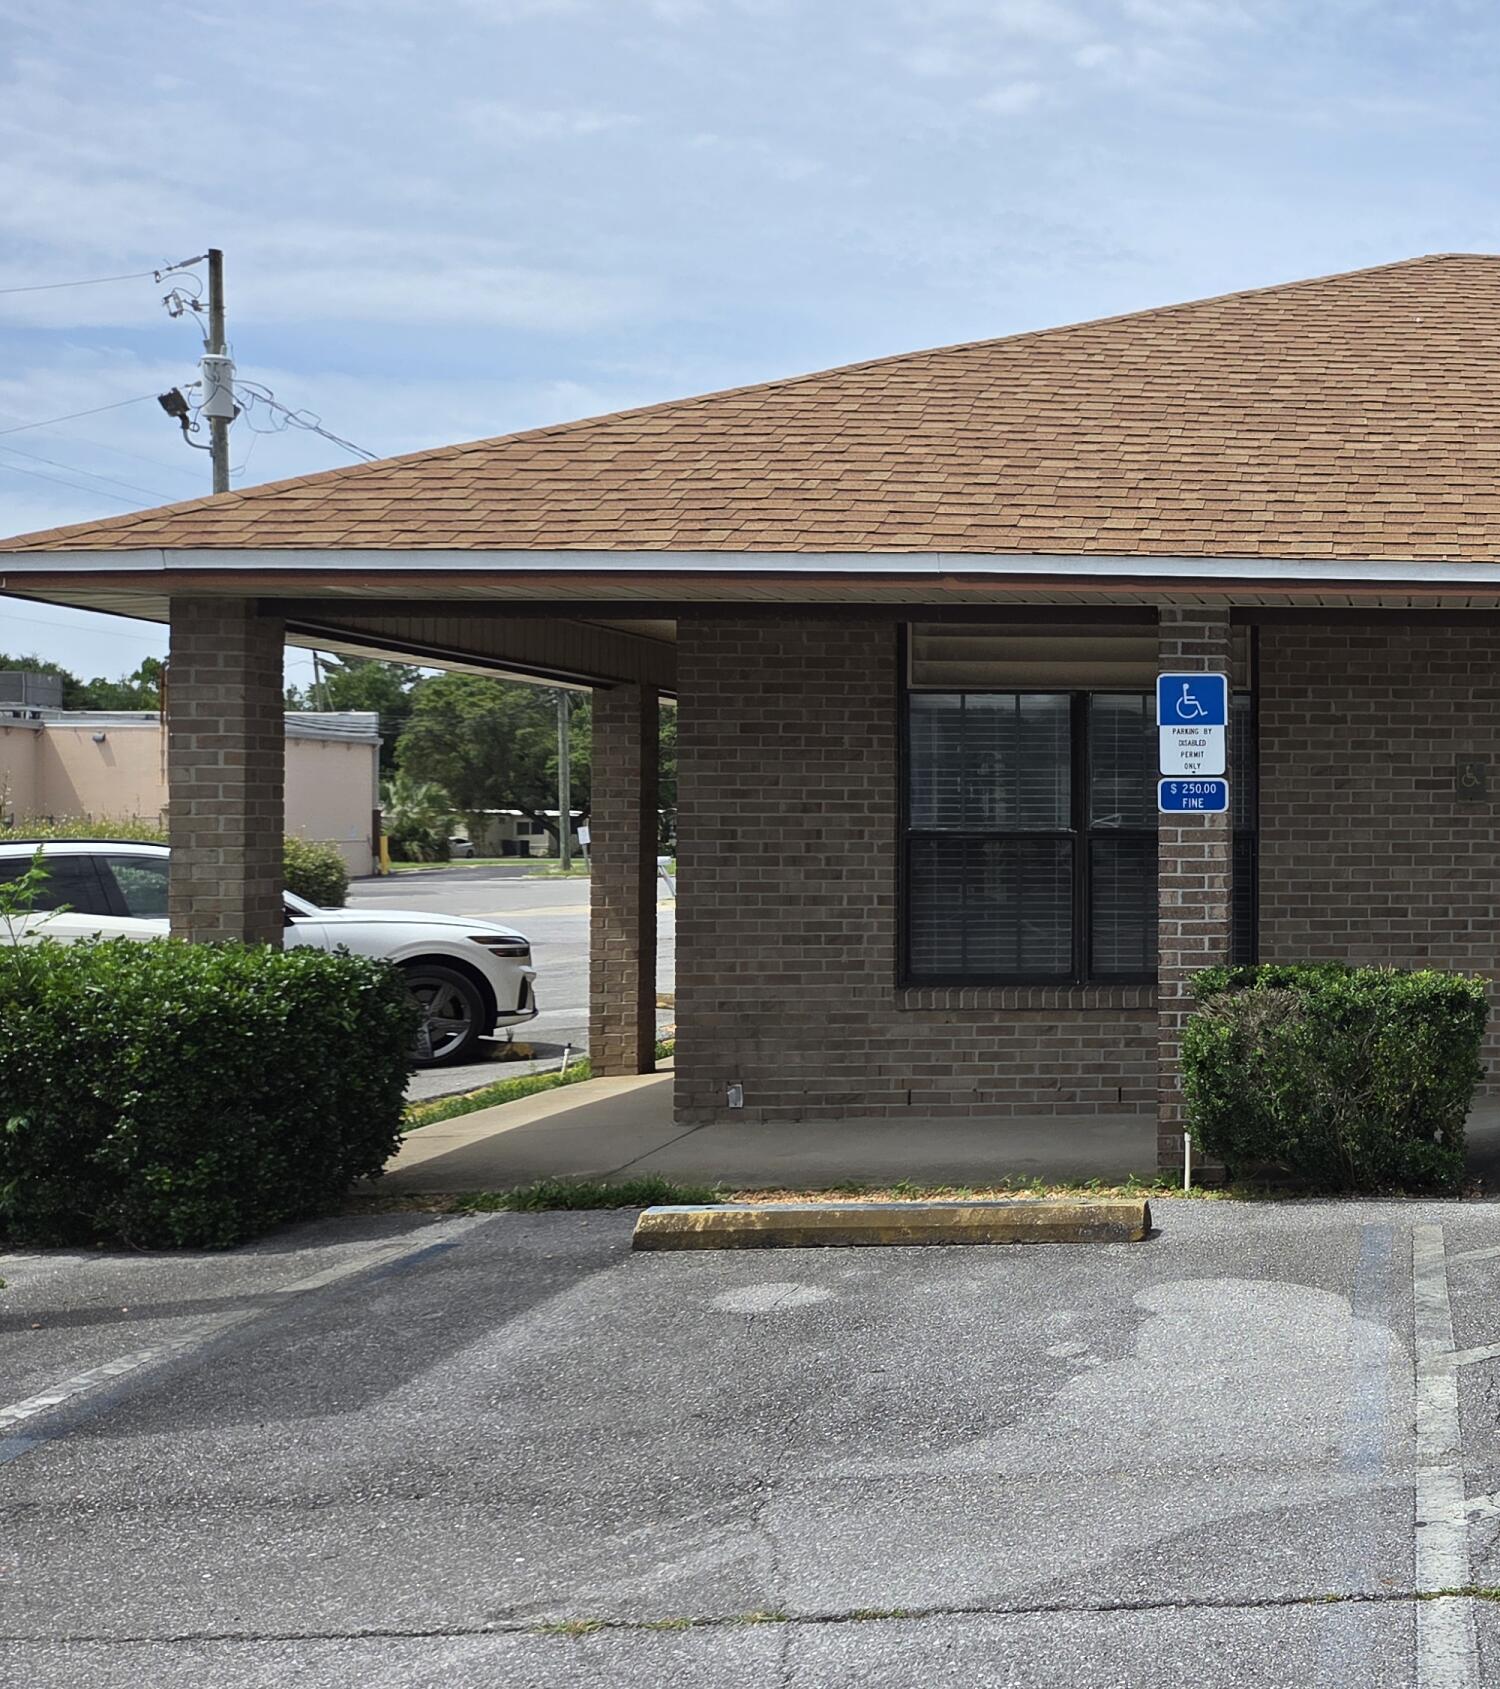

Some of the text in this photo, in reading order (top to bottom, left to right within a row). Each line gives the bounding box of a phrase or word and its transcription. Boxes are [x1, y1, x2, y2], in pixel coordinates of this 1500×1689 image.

[1178, 739, 1206, 747] DISABLED
[1184, 762, 1201, 770] ONLY
[1170, 784, 1217, 795] $ 250.00
[1183, 798, 1204, 809] FINE
